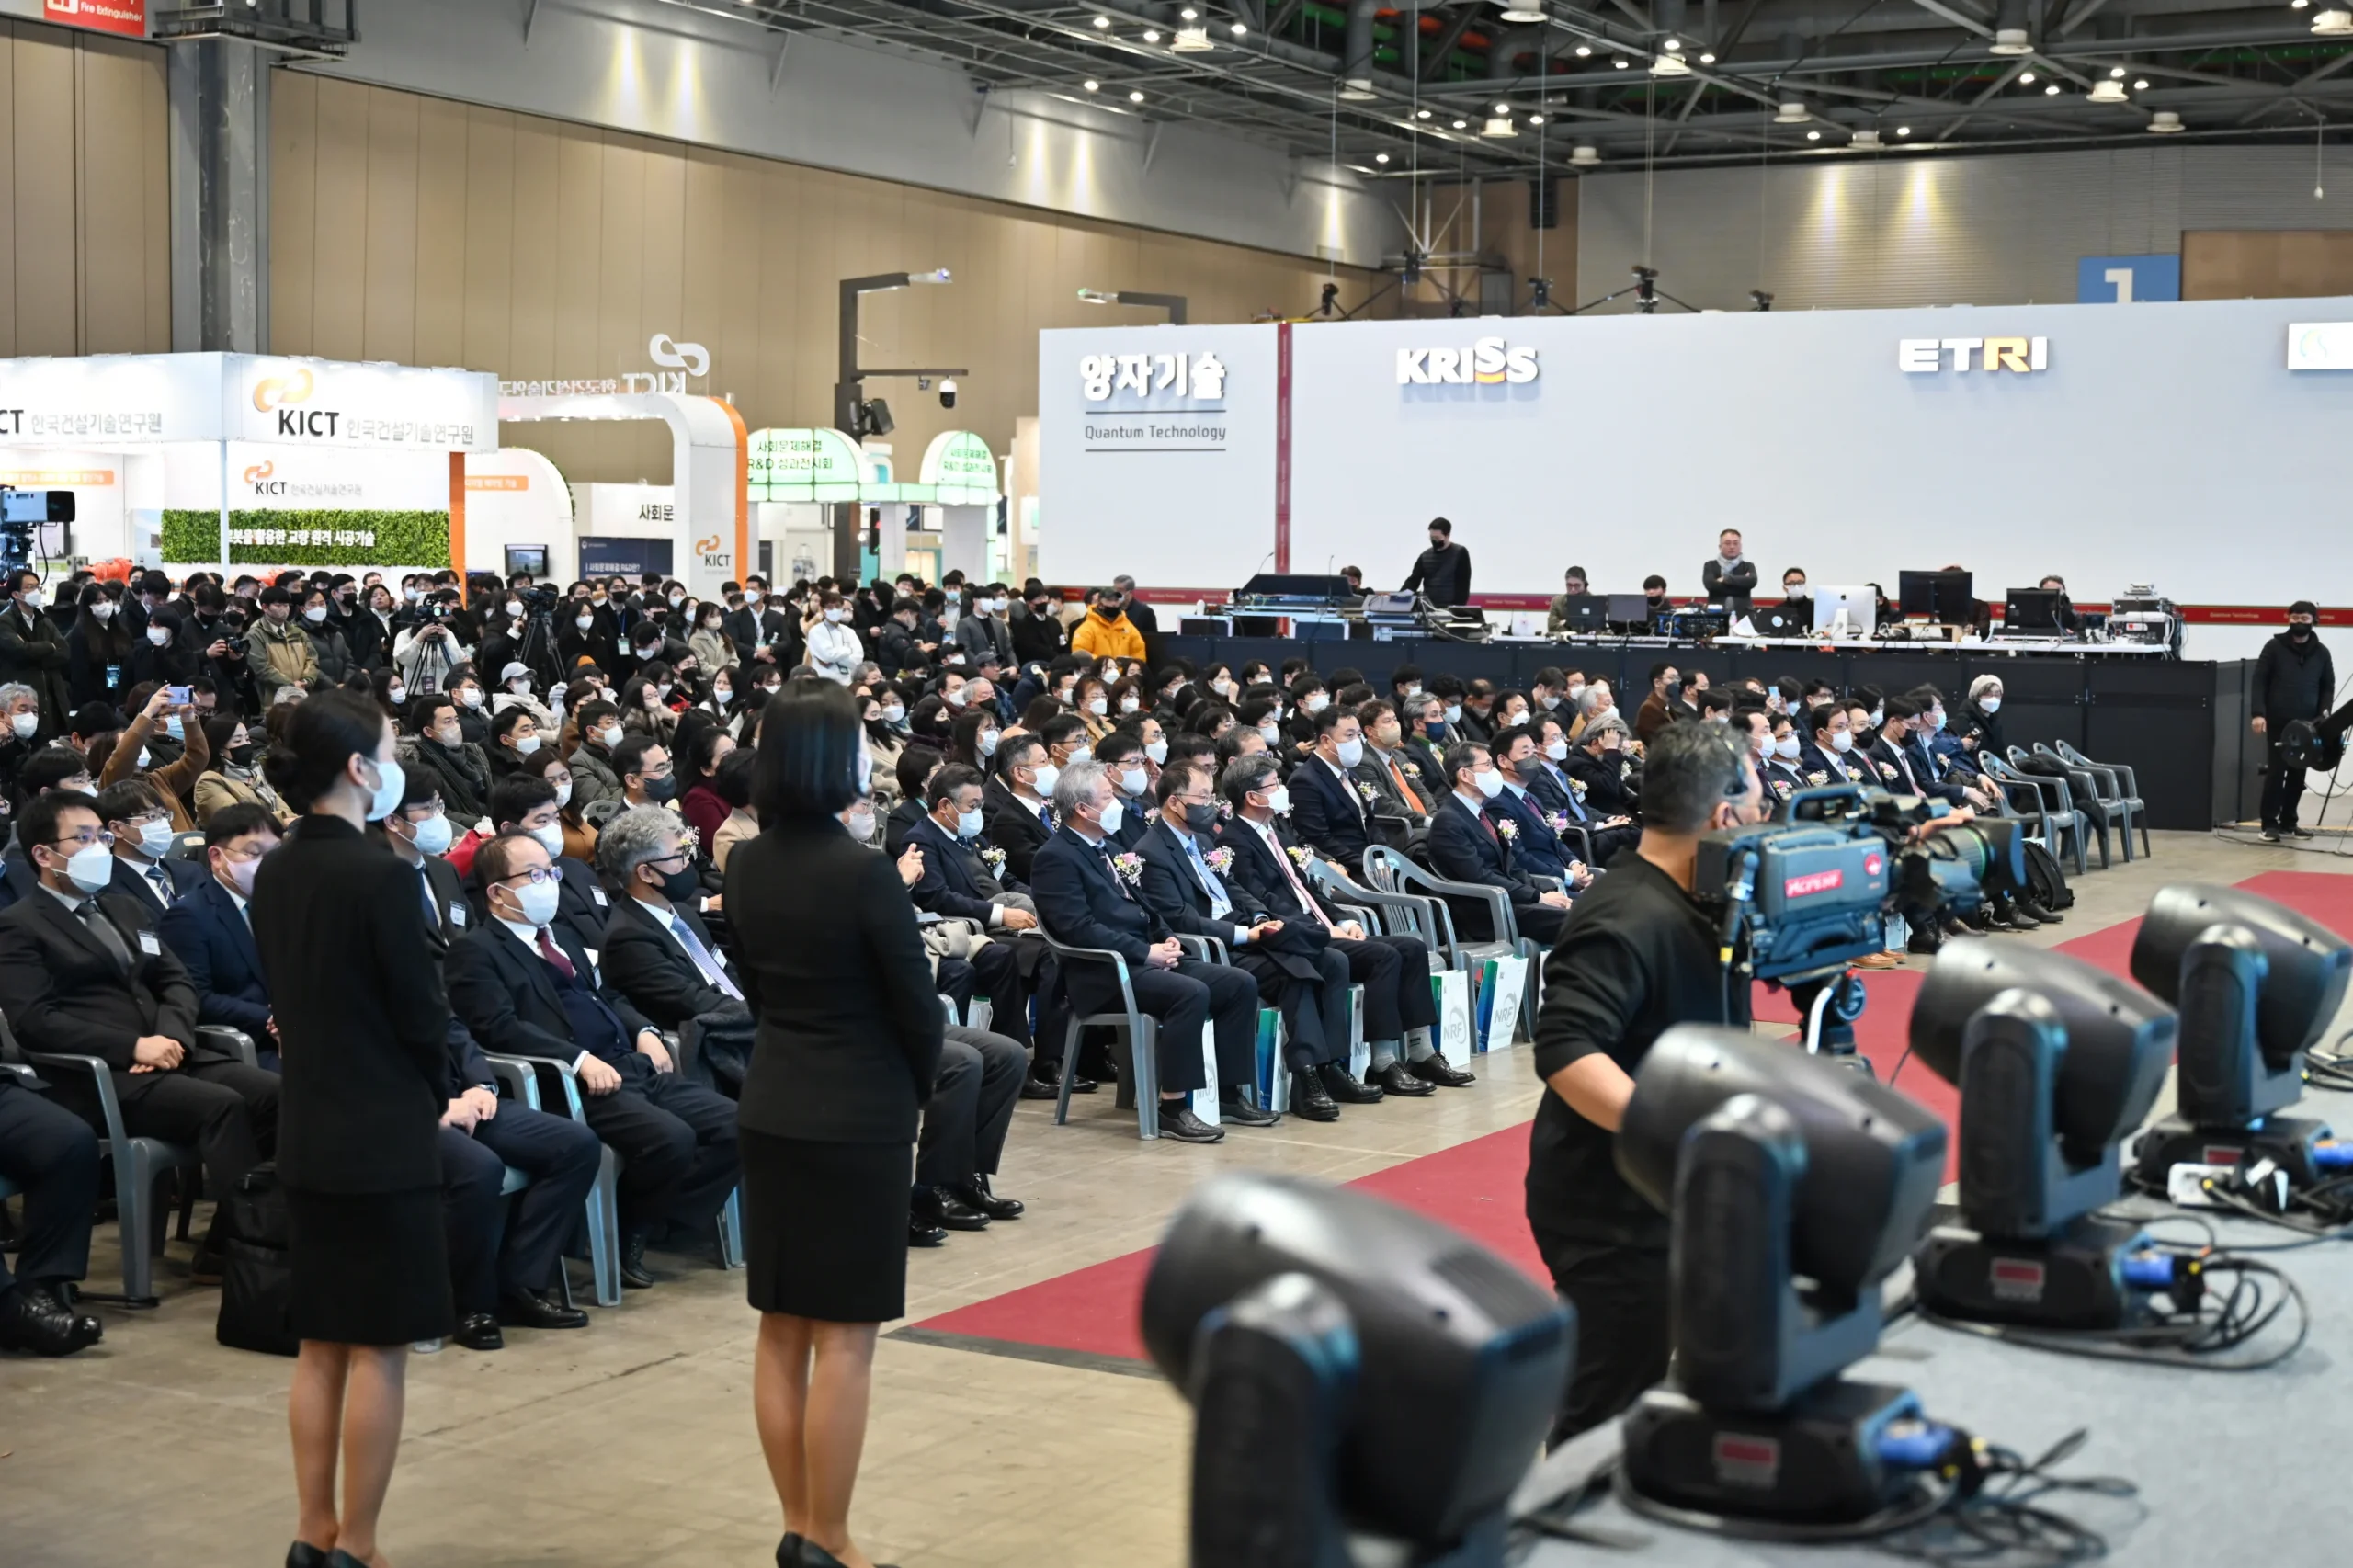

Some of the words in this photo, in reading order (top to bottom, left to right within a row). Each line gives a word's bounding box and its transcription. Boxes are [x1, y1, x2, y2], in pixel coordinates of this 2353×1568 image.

[80, 2, 96, 13] Fire
[97, 6, 142, 22] Extinguisher
[1396, 336, 1540, 384] KRISS
[1899, 336, 2048, 372] ETRI
[1079, 351, 1227, 401] 양자기술
[31, 412, 162, 435] 한국건설기술연구원
[278, 409, 340, 437] KICT
[347, 418, 473, 445] 한국건설기술연구원
[1085, 425, 1144, 440] Quantum
[1149, 425, 1226, 441] Technology
[757, 440, 822, 452] 사회문제해결
[779, 458, 833, 470] 성과전시회
[256, 481, 287, 494] KICT
[288, 529, 310, 546] 교량
[311, 529, 332, 546] 원격
[334, 529, 375, 547] 시공기술
[705, 554, 731, 567] KICT
[1495, 1007, 1514, 1024] NRF
[1443, 1023, 1462, 1040] NRF
